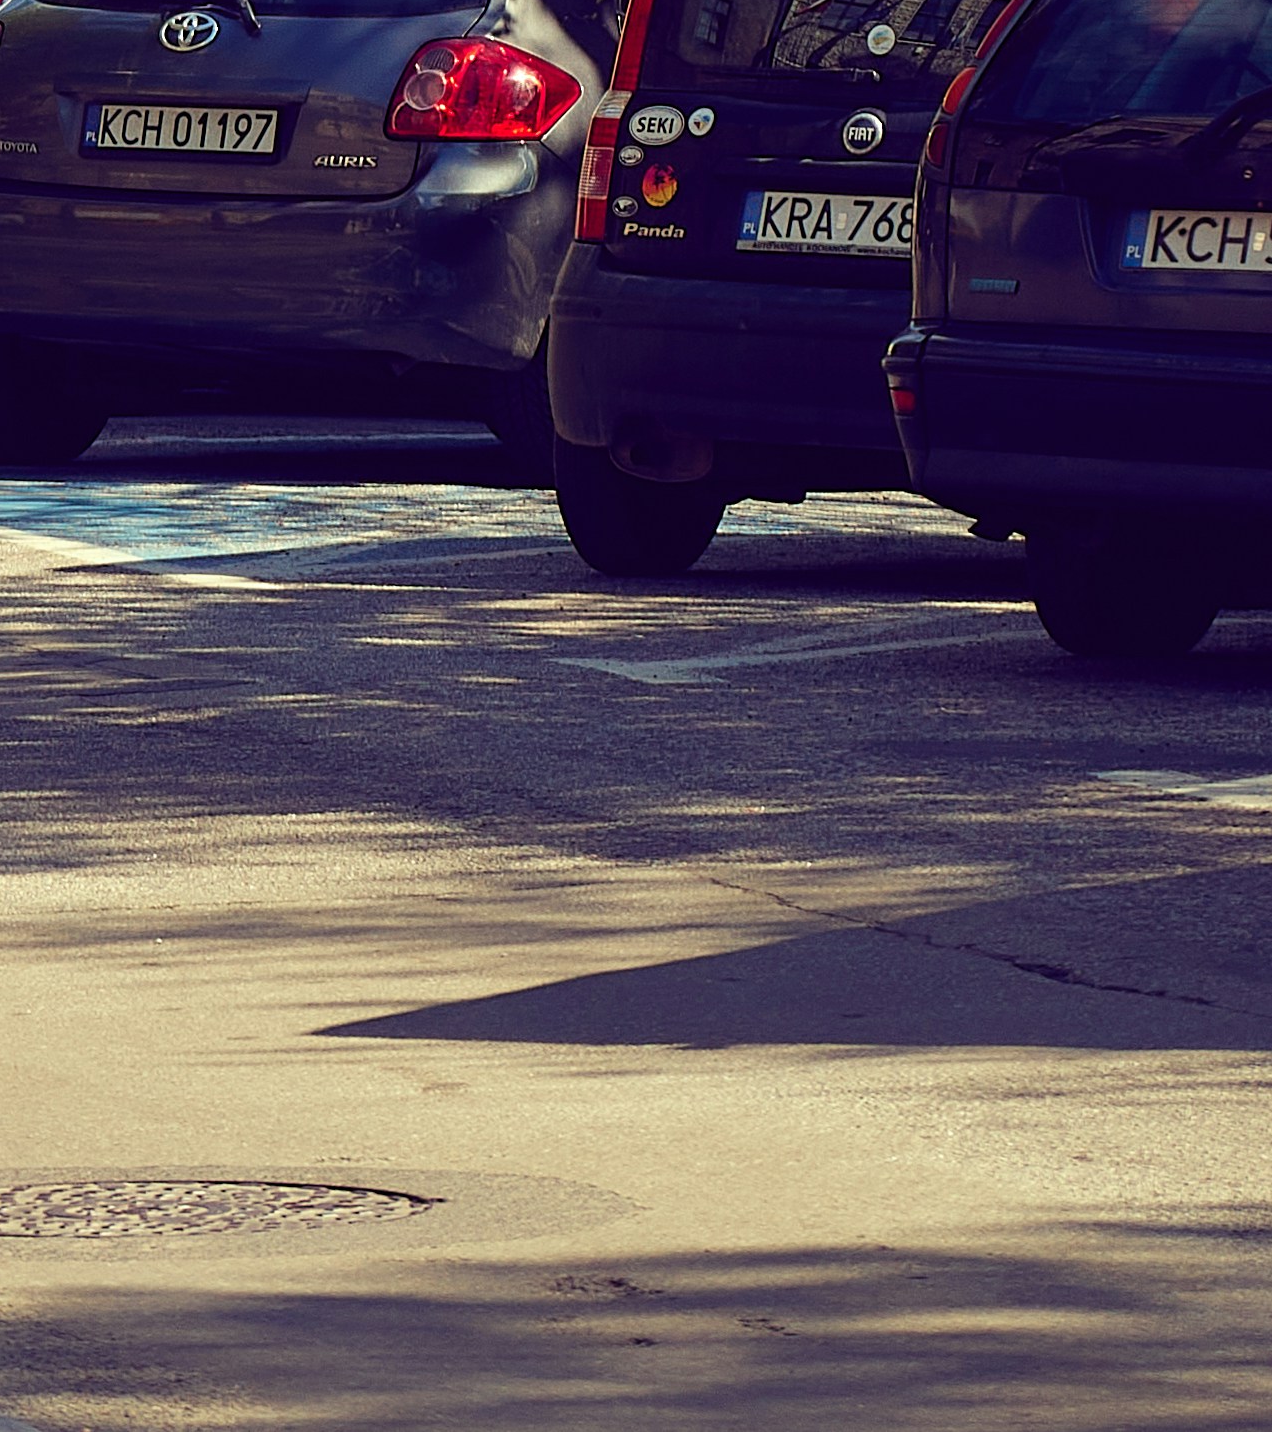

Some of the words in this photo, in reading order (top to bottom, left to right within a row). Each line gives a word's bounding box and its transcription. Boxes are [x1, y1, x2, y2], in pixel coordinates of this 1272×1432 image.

[85, 131, 97, 143] PL
[100, 108, 165, 147] KCH
[172, 110, 275, 151] 01197
[636, 116, 675, 134] SEKI
[848, 126, 875, 142] FIAT
[313, 154, 378, 169] AURIS
[742, 222, 756, 234] PL
[760, 196, 833, 240] KRA
[847, 199, 913, 244] 768
[623, 222, 686, 239] Panda
[1126, 245, 1141, 259] PL
[1149, 215, 1253, 264] KCH
